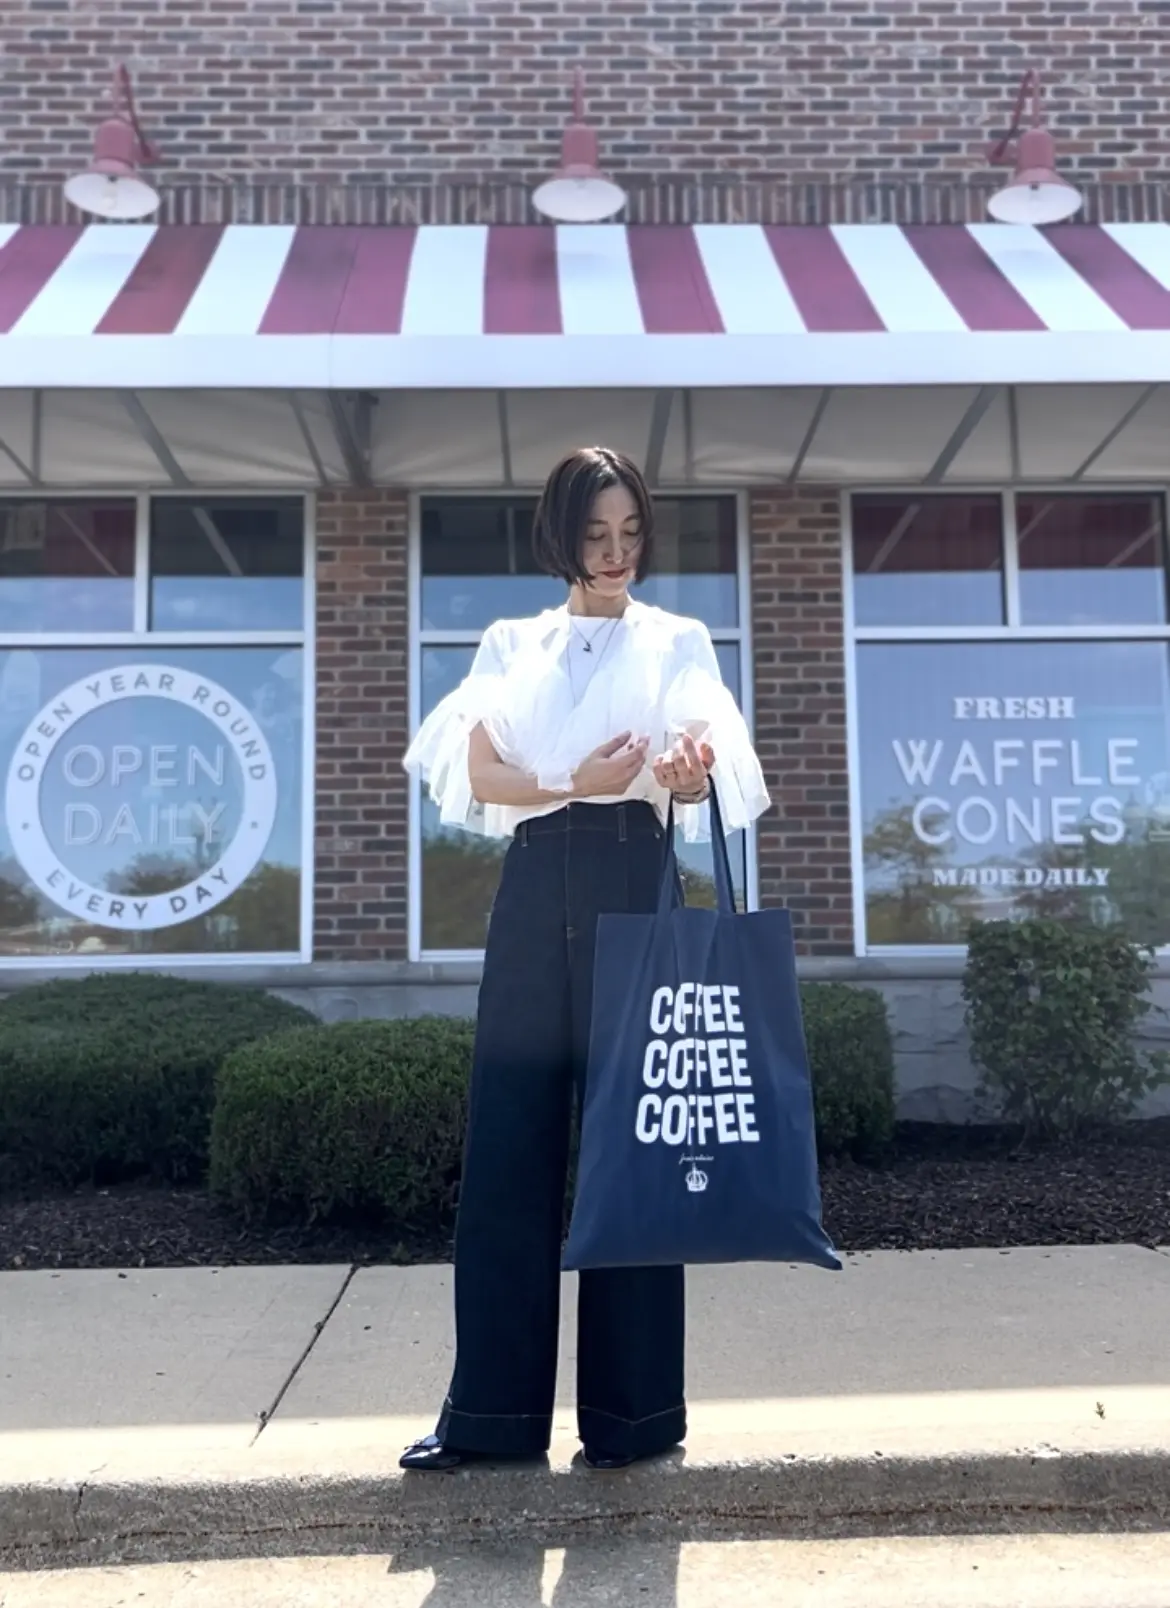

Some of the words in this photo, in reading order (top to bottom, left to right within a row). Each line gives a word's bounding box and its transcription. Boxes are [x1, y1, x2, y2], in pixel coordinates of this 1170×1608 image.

[17, 702, 73, 782] OPEN
[86, 671, 175, 699] YEAR
[193, 685, 267, 780] ROUND
[953, 697, 1076, 719] FRESH
[62, 744, 226, 787] OPEN
[891, 738, 1142, 786] WAFFLE
[63, 802, 228, 845] DAILY
[912, 796, 1126, 845] CONES
[46, 868, 148, 919] EVERY
[169, 867, 229, 914] DAY
[932, 868, 1017, 887] MADE
[1023, 867, 1111, 887] DAILY
[642, 1037, 752, 1090] COFFEE
[635, 1093, 760, 1146] COFFEE
